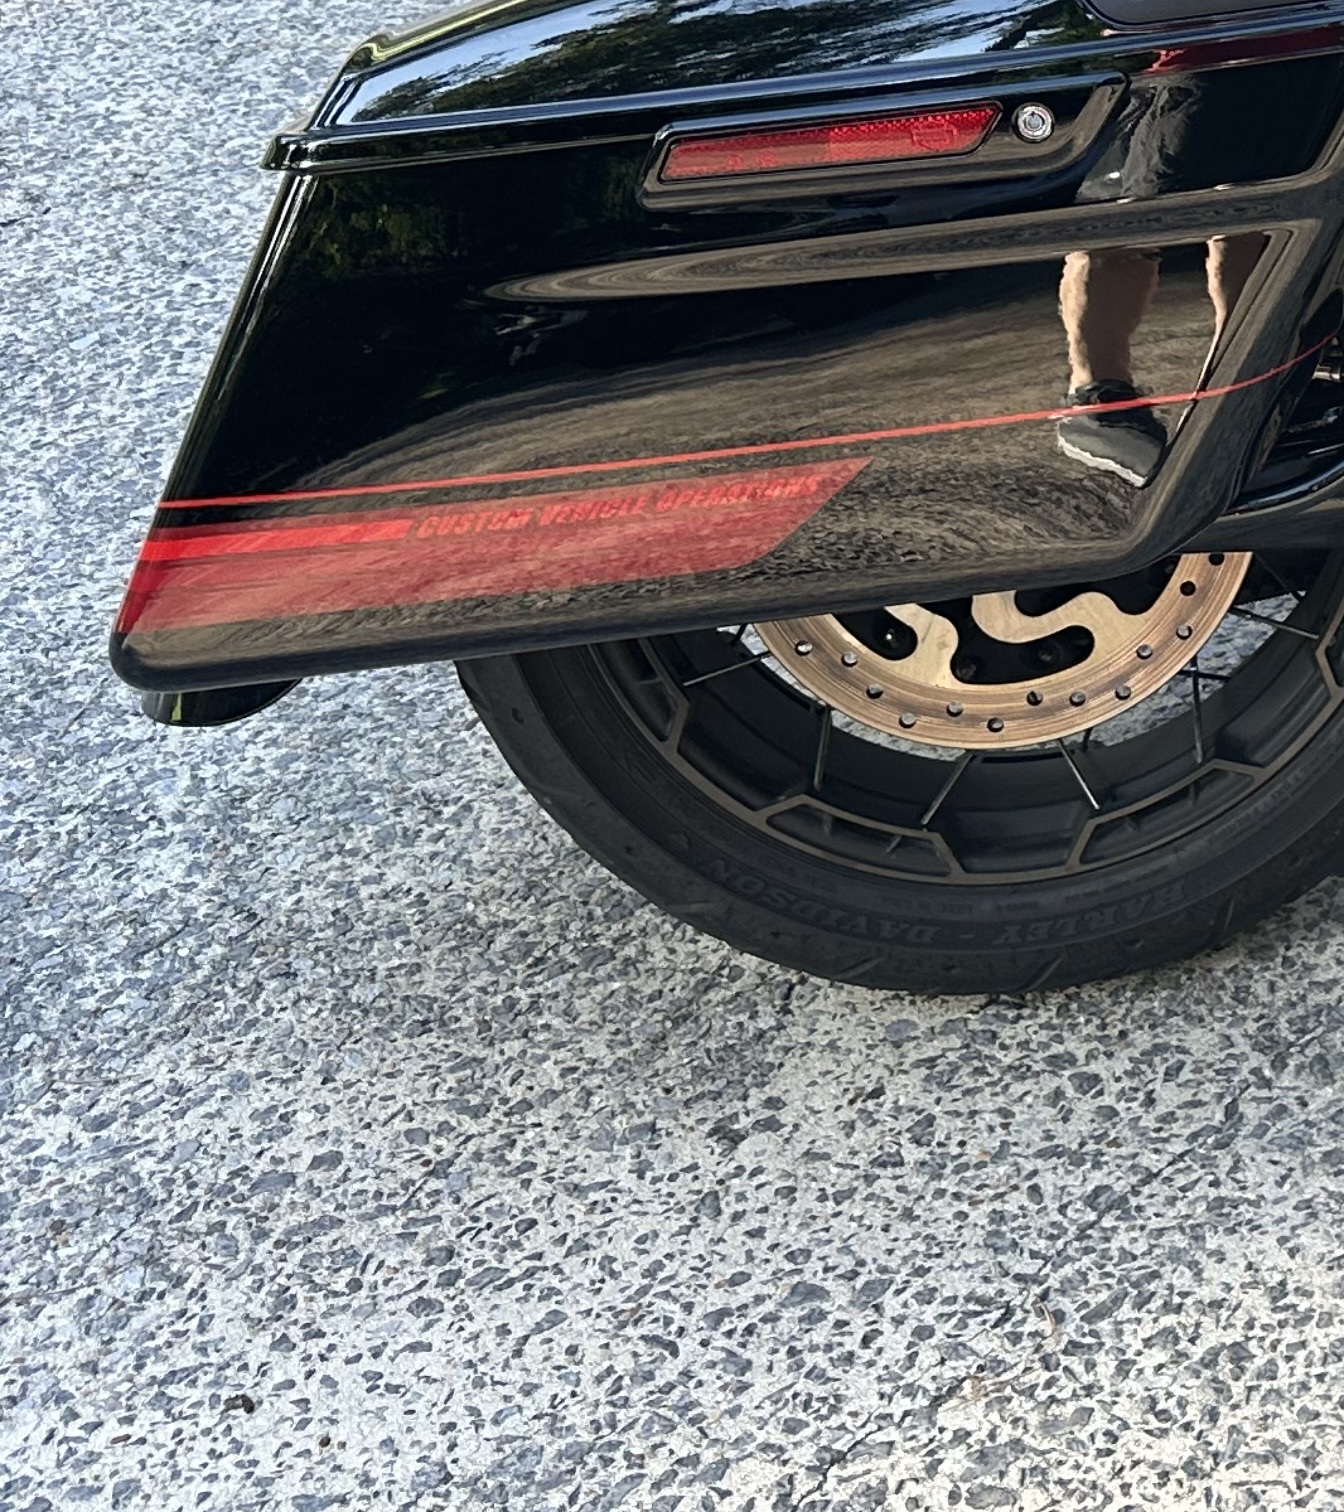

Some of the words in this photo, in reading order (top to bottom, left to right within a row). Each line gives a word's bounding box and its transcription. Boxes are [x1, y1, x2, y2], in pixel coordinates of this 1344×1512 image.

[415, 507, 535, 538] CUSTOM
[539, 495, 648, 526] VEHICLE
[705, 858, 942, 945] DAVIDSON
[990, 880, 1187, 946] HARLEY
